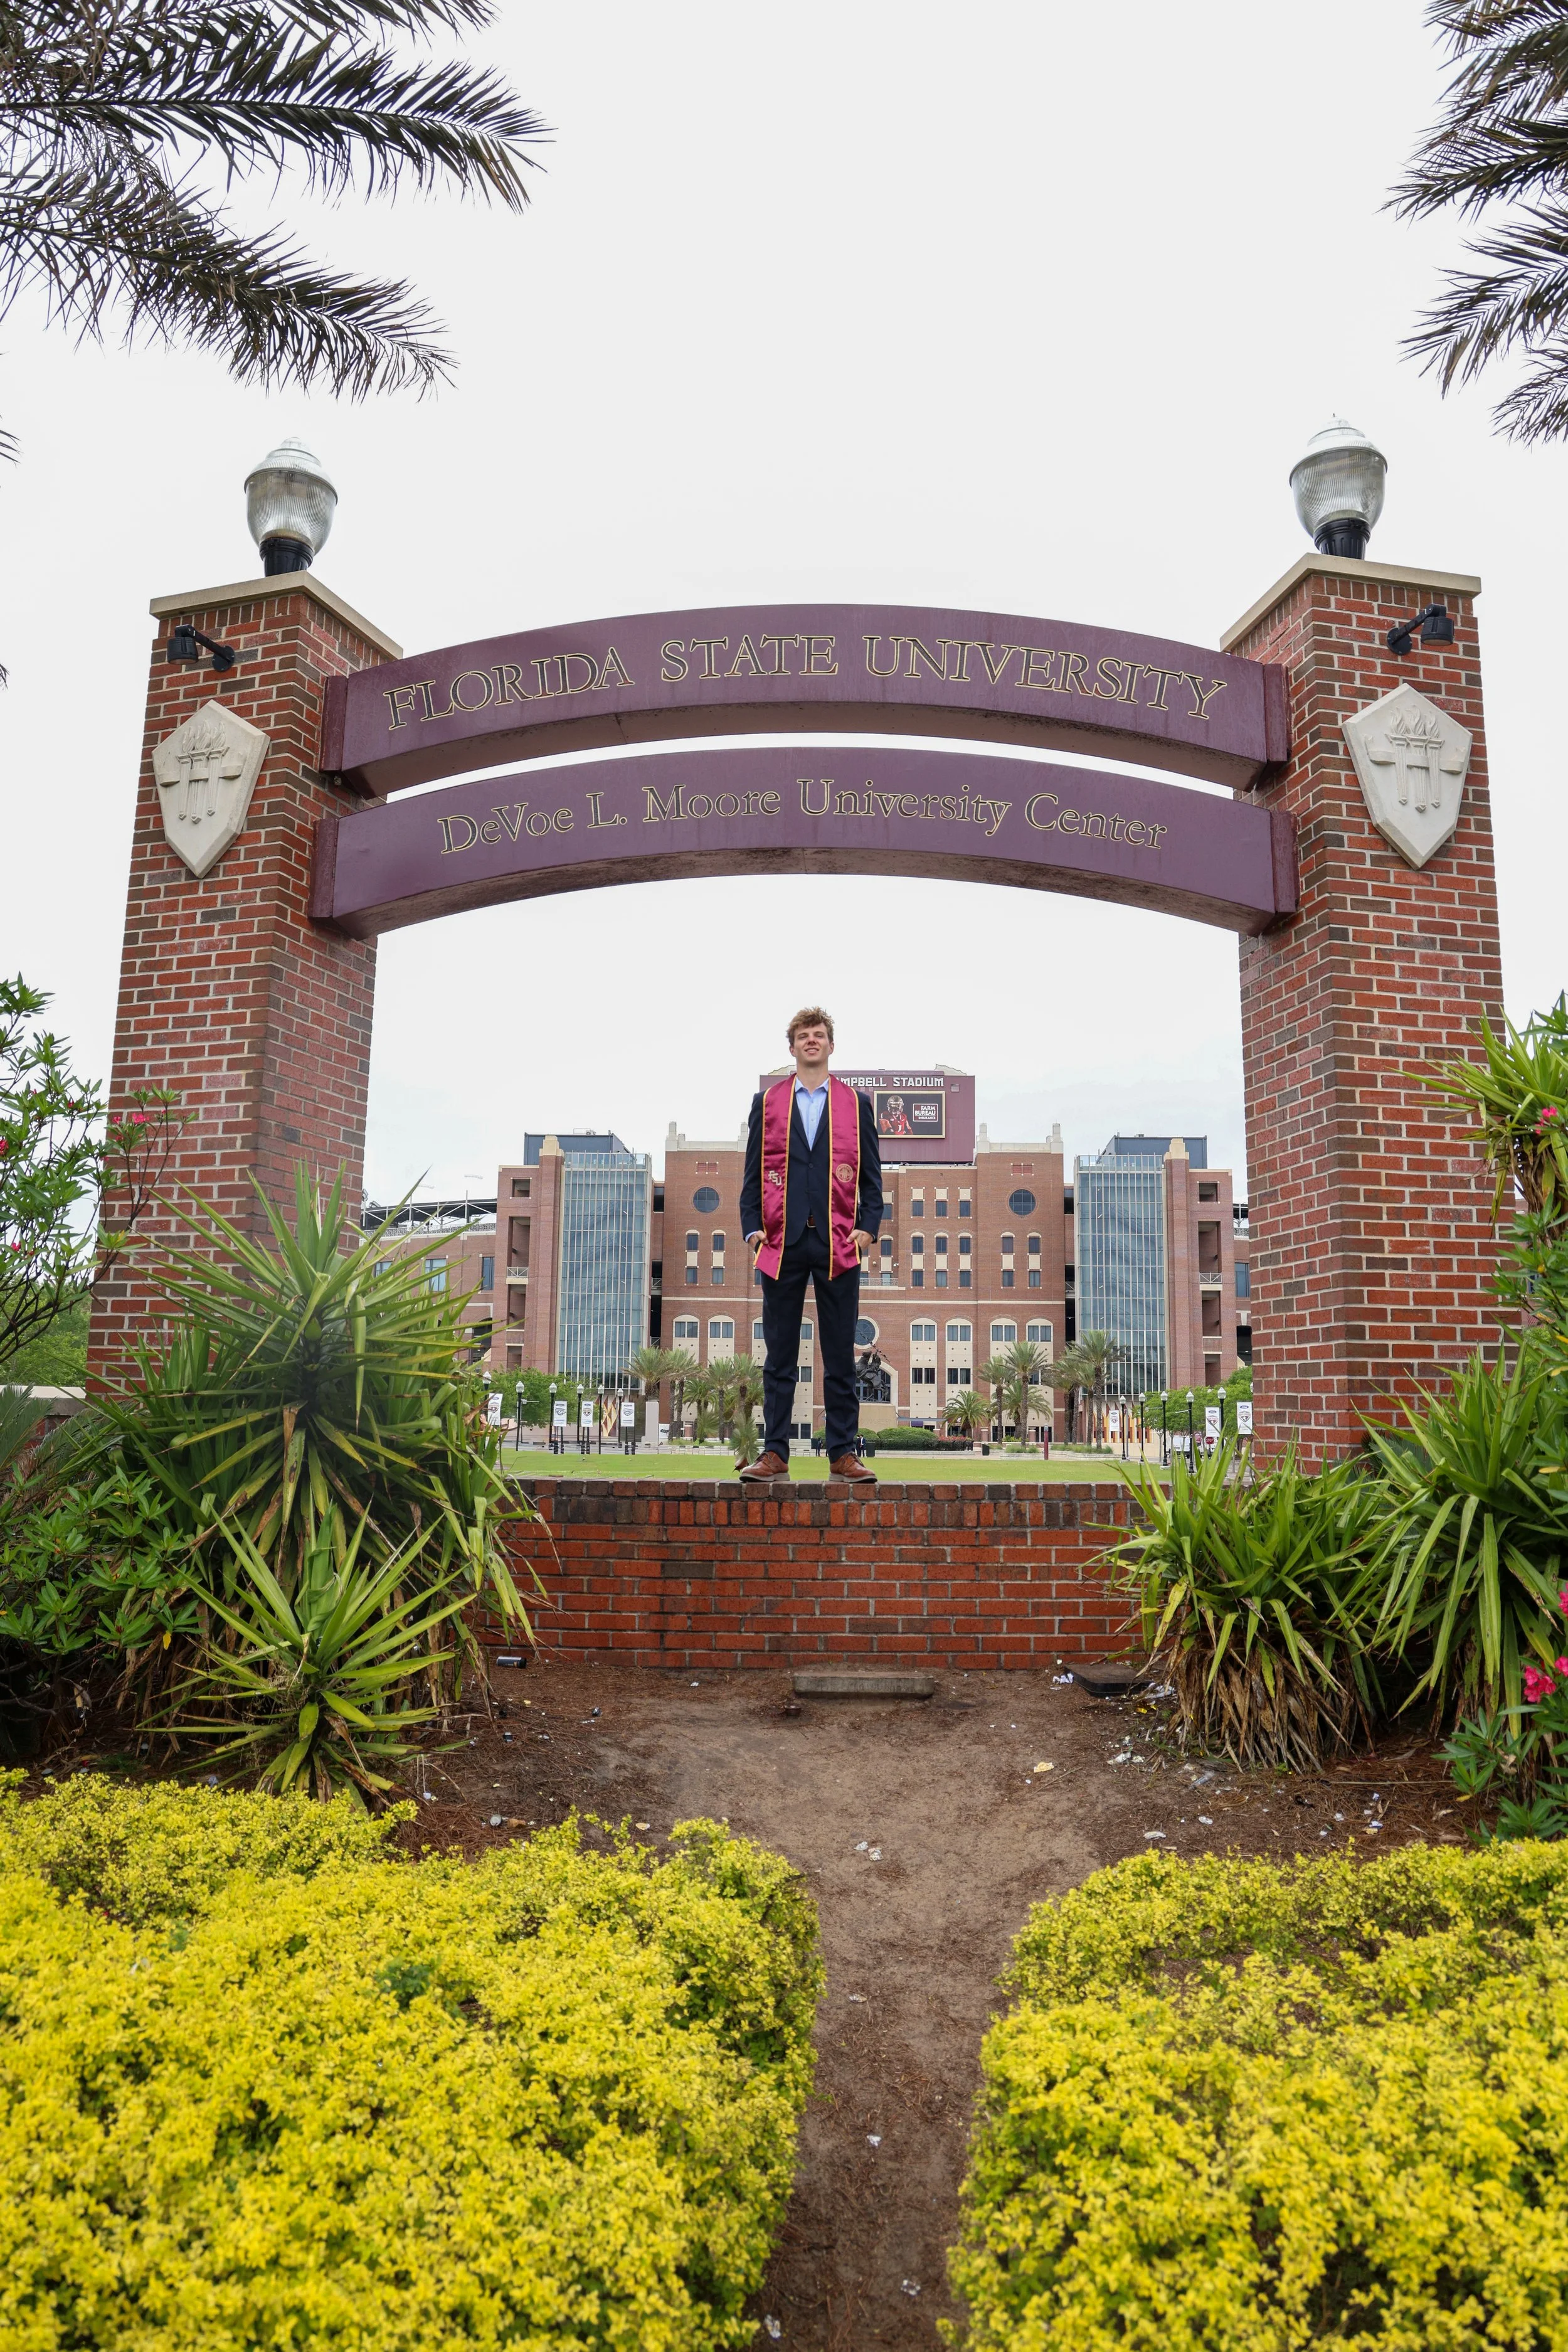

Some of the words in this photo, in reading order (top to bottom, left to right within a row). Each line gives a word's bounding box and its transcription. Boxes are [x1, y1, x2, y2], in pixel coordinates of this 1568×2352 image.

[383, 647, 634, 730] FLORIDA
[660, 635, 838, 682] STATE
[863, 636, 1227, 719] UNIVERSITY
[438, 803, 574, 854] DeVoe
[586, 792, 627, 828] L.
[642, 784, 781, 822] Moore
[797, 779, 1012, 837] University
[1025, 793, 1167, 849] Center
[836, 1077, 887, 1087] MPBELL
[893, 1077, 944, 1087] STADIUM
[768, 1170, 782, 1185] FSU
